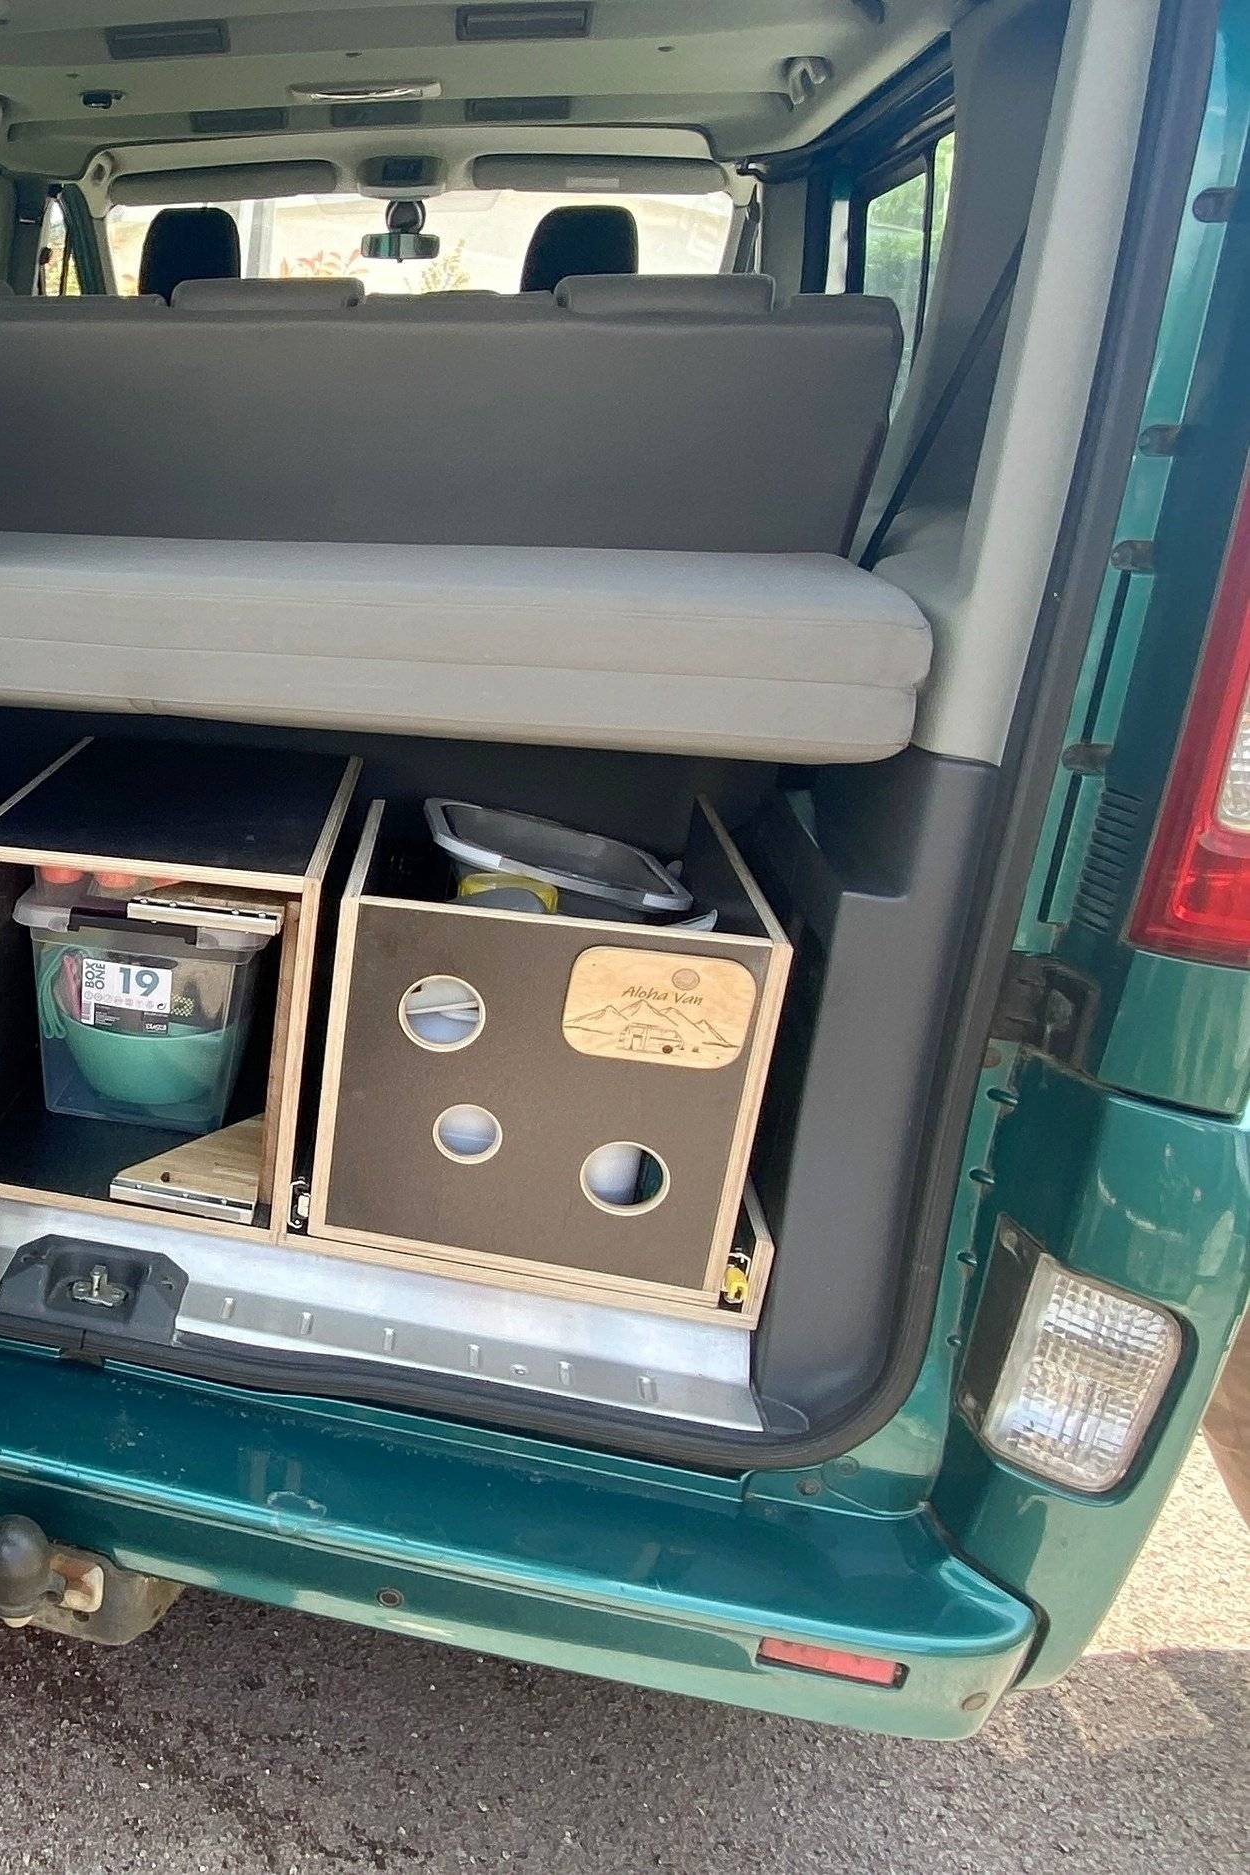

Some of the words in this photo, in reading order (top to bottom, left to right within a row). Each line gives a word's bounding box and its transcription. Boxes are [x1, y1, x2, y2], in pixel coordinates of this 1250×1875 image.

[85, 962, 95, 988] BOX
[95, 963, 106, 989] ONE
[119, 967, 159, 997] 19
[622, 986, 668, 1001] Aloha
[674, 992, 703, 1006] Van
